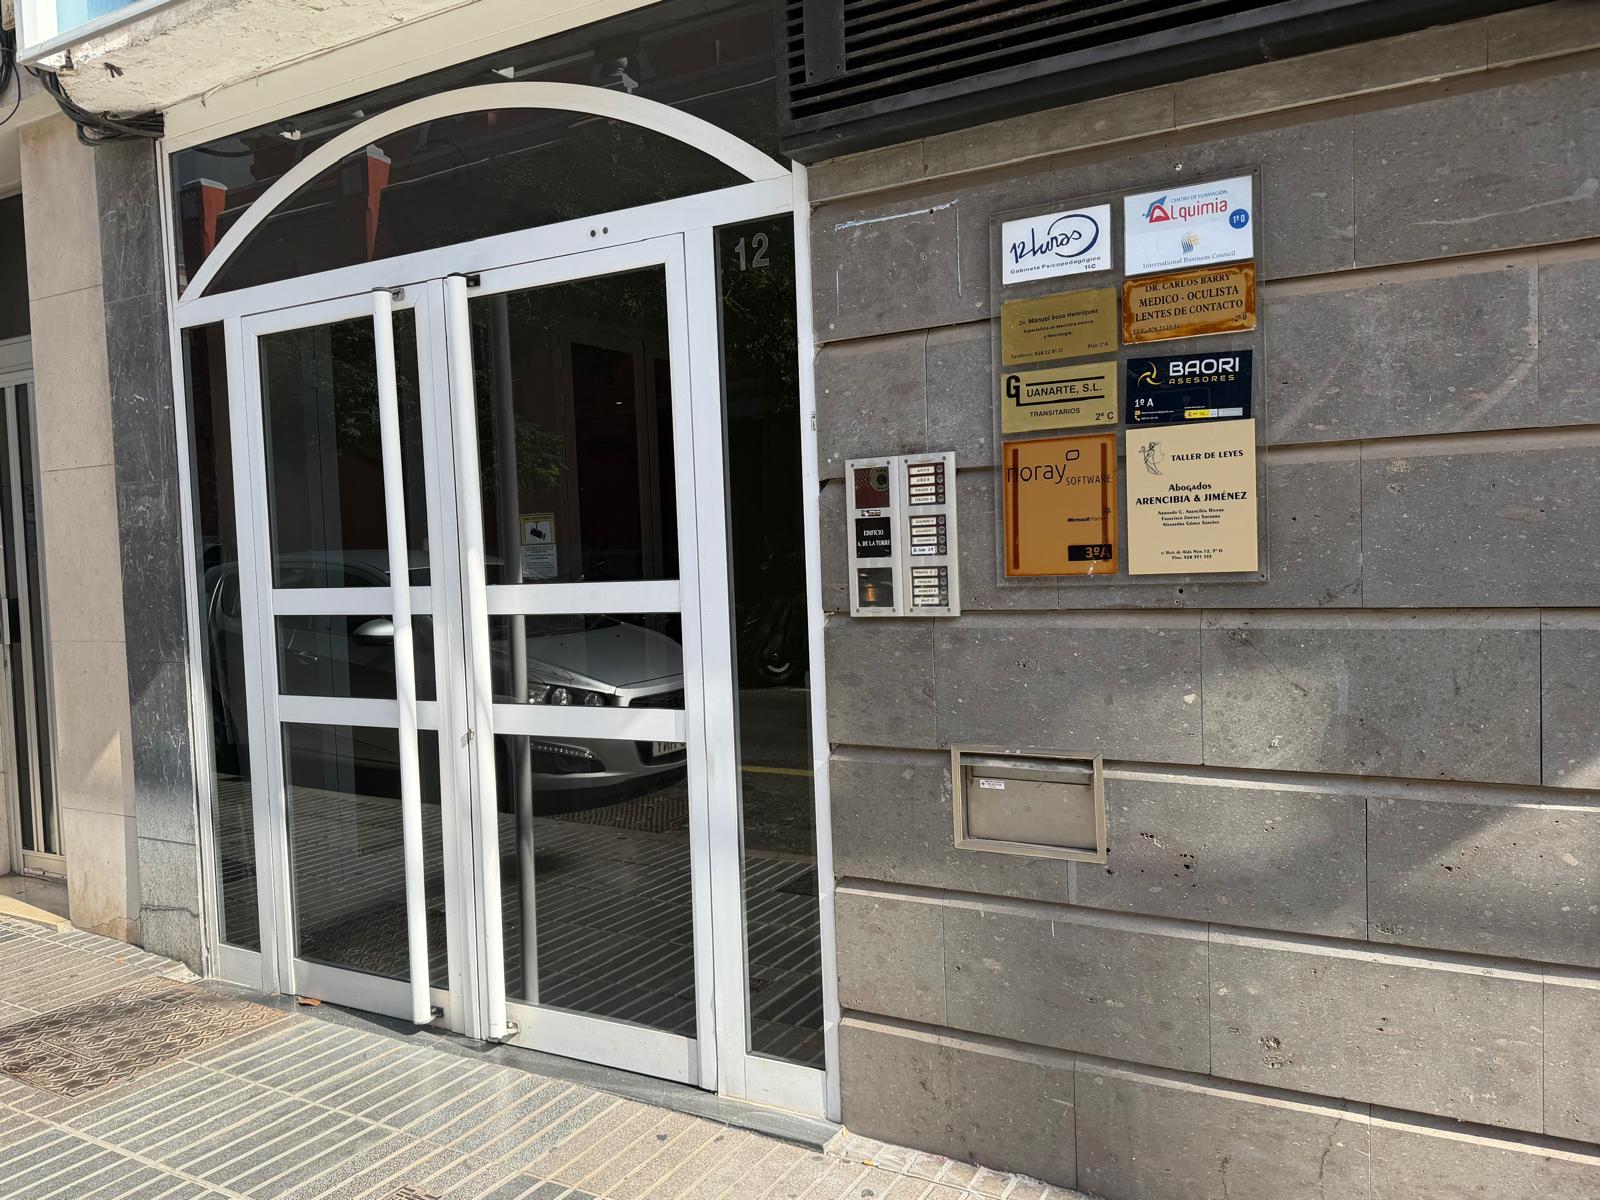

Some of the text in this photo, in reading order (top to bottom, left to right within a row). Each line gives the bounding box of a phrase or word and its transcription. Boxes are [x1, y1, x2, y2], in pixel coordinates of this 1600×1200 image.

[1170, 195, 1189, 203] CENTRO
[734, 232, 770, 271] 12
[1142, 250, 1236, 269] International Business Council
[1010, 256, 1101, 274] Gabinete Psicopedagógico
[1145, 273, 1231, 293] DR. CARLOS BARRY
[1138, 293, 1179, 308] MEDICO
[1187, 285, 1239, 301] OCULISTA
[1135, 299, 1243, 322] LENTES DE CONTACTO
[1028, 314, 1051, 325] Manuel
[1169, 357, 1240, 377] BAORI
[1168, 374, 1235, 385] ASESORES
[1082, 383, 1102, 393] S.L.
[1029, 407, 1080, 418] TRANSITARIOS
[1171, 449, 1244, 462] TALLER DE LEYES
[1007, 463, 1067, 485] noray
[1066, 474, 1111, 486] SOFTWARE
[1135, 490, 1248, 506] ARENCIBIA & JIMÉNEZ
[863, 529, 884, 537] EDIFICIO
